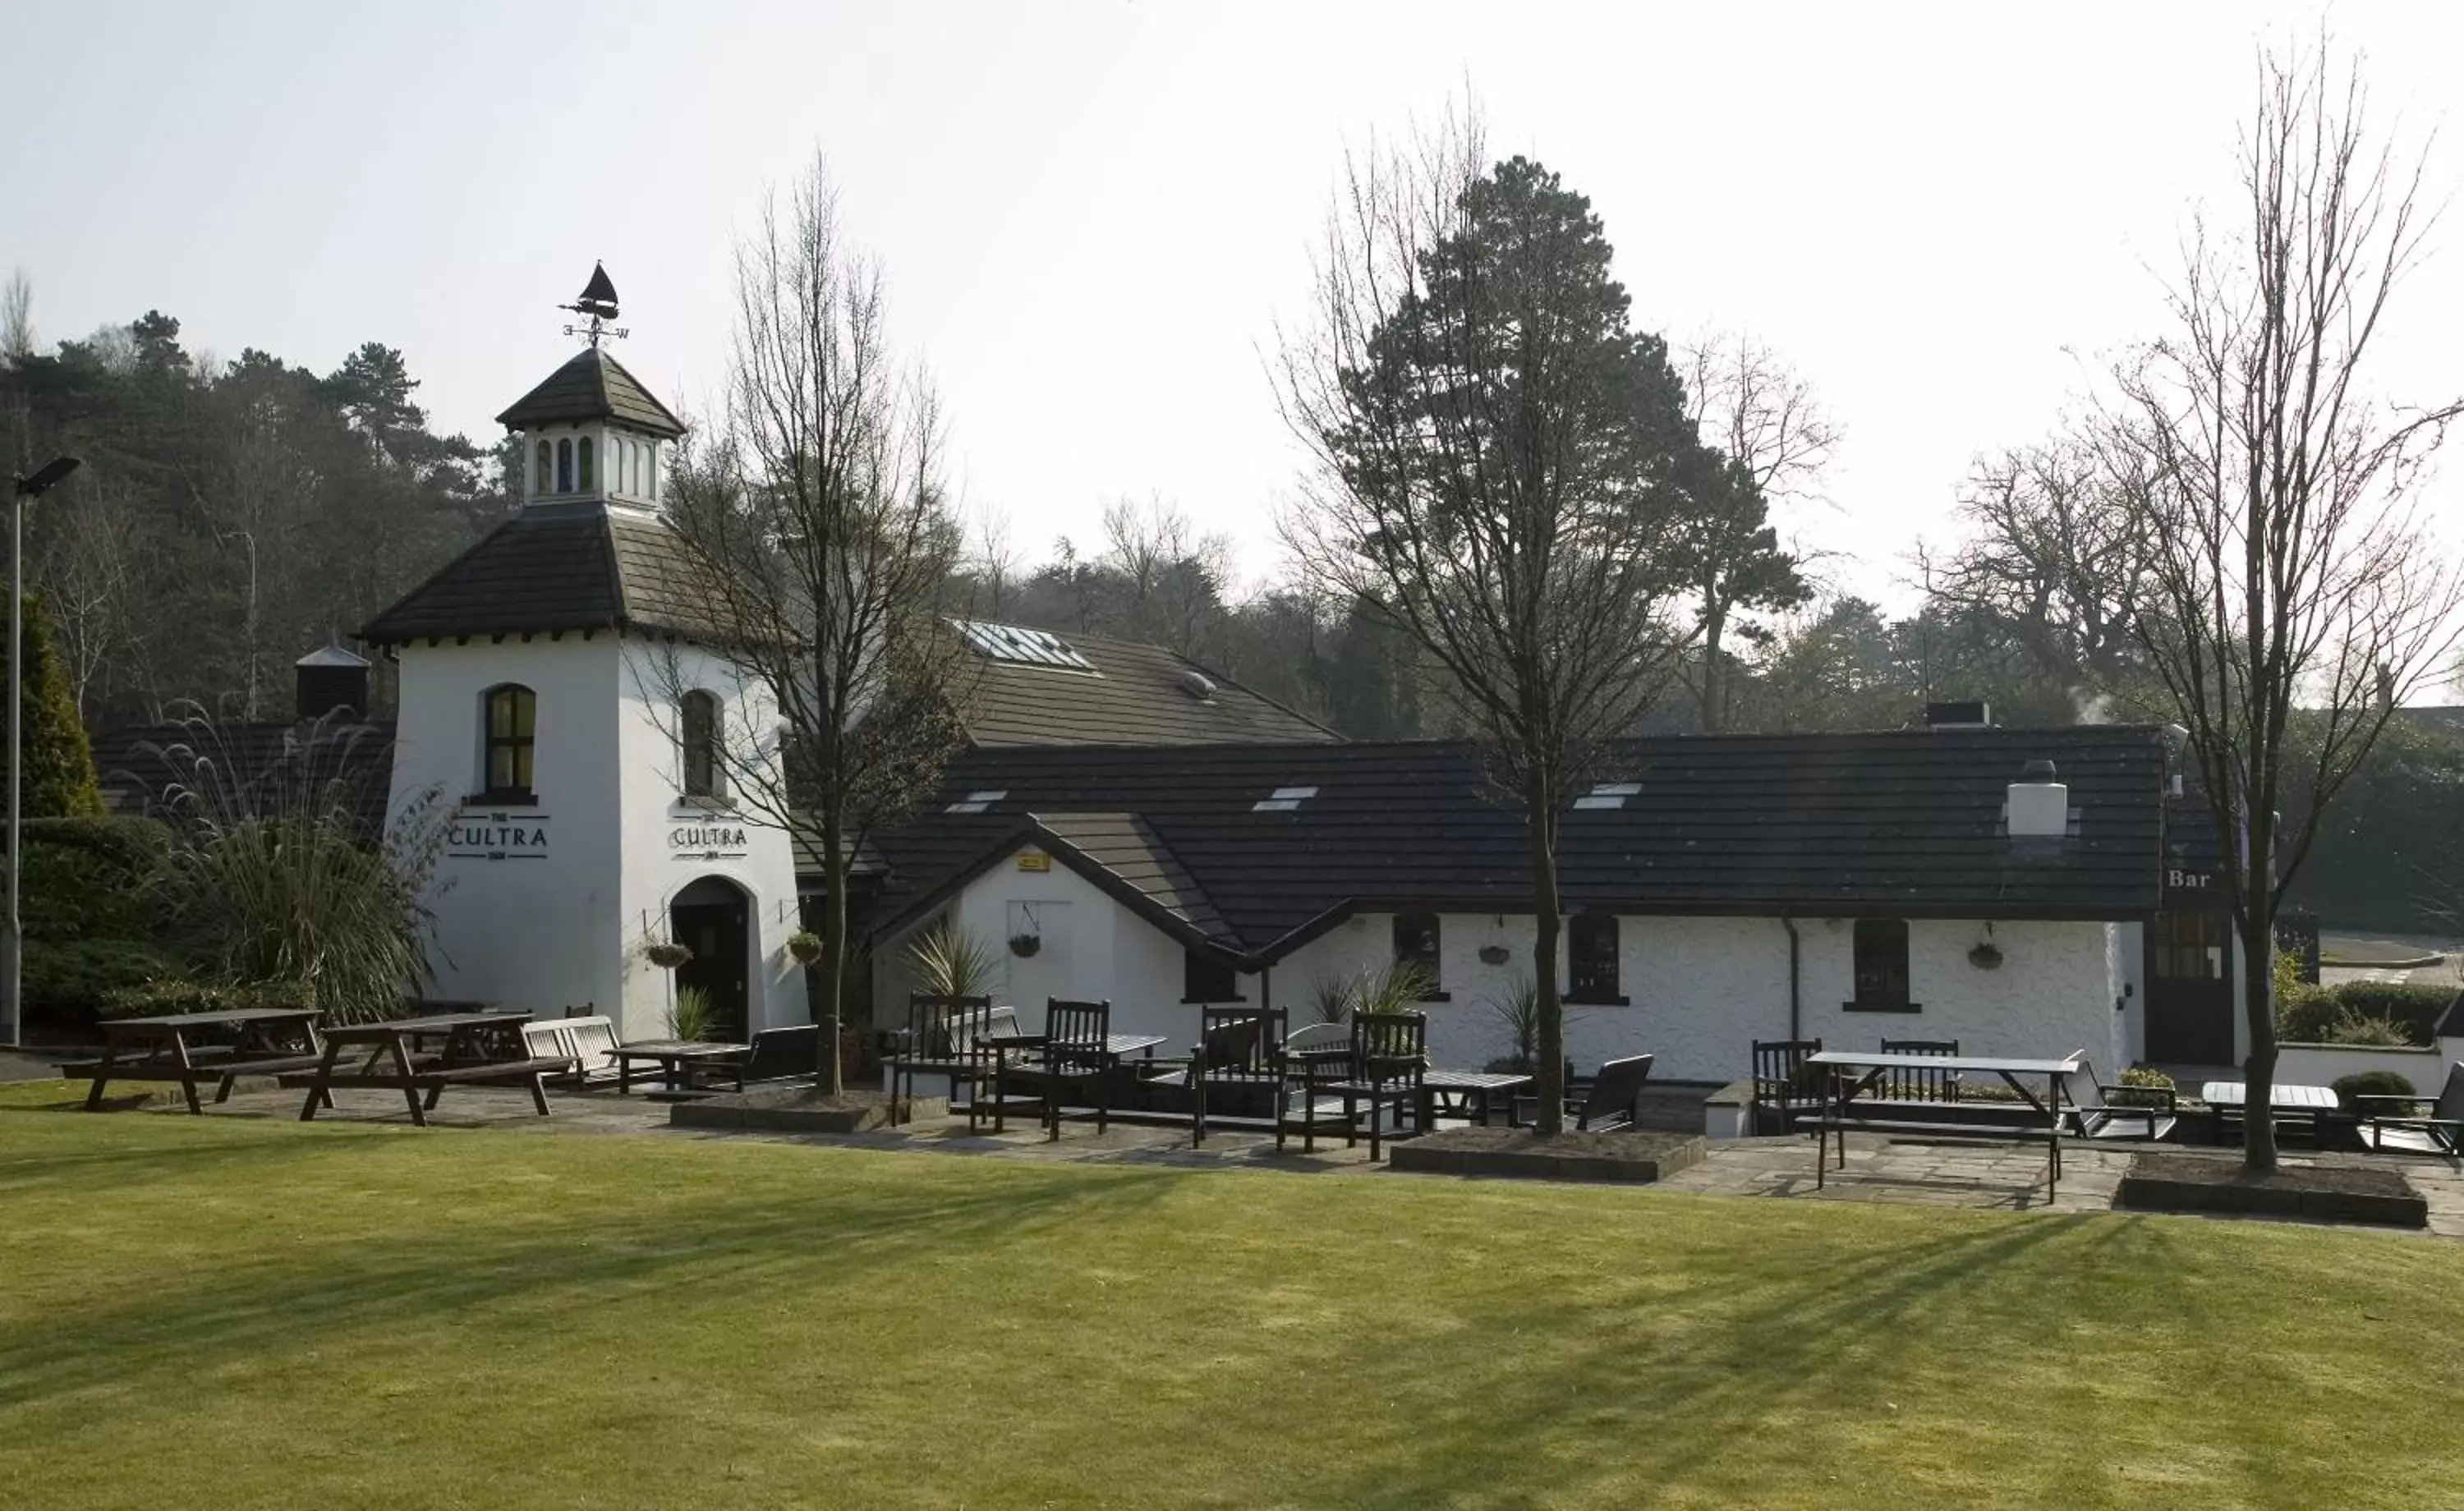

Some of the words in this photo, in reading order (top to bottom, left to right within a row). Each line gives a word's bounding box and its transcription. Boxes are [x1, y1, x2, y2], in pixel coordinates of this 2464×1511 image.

[616, 328, 629, 338] W
[449, 827, 547, 845] CULTRA
[674, 827, 747, 845] CULTRA
[2168, 870, 2211, 888] Bar
